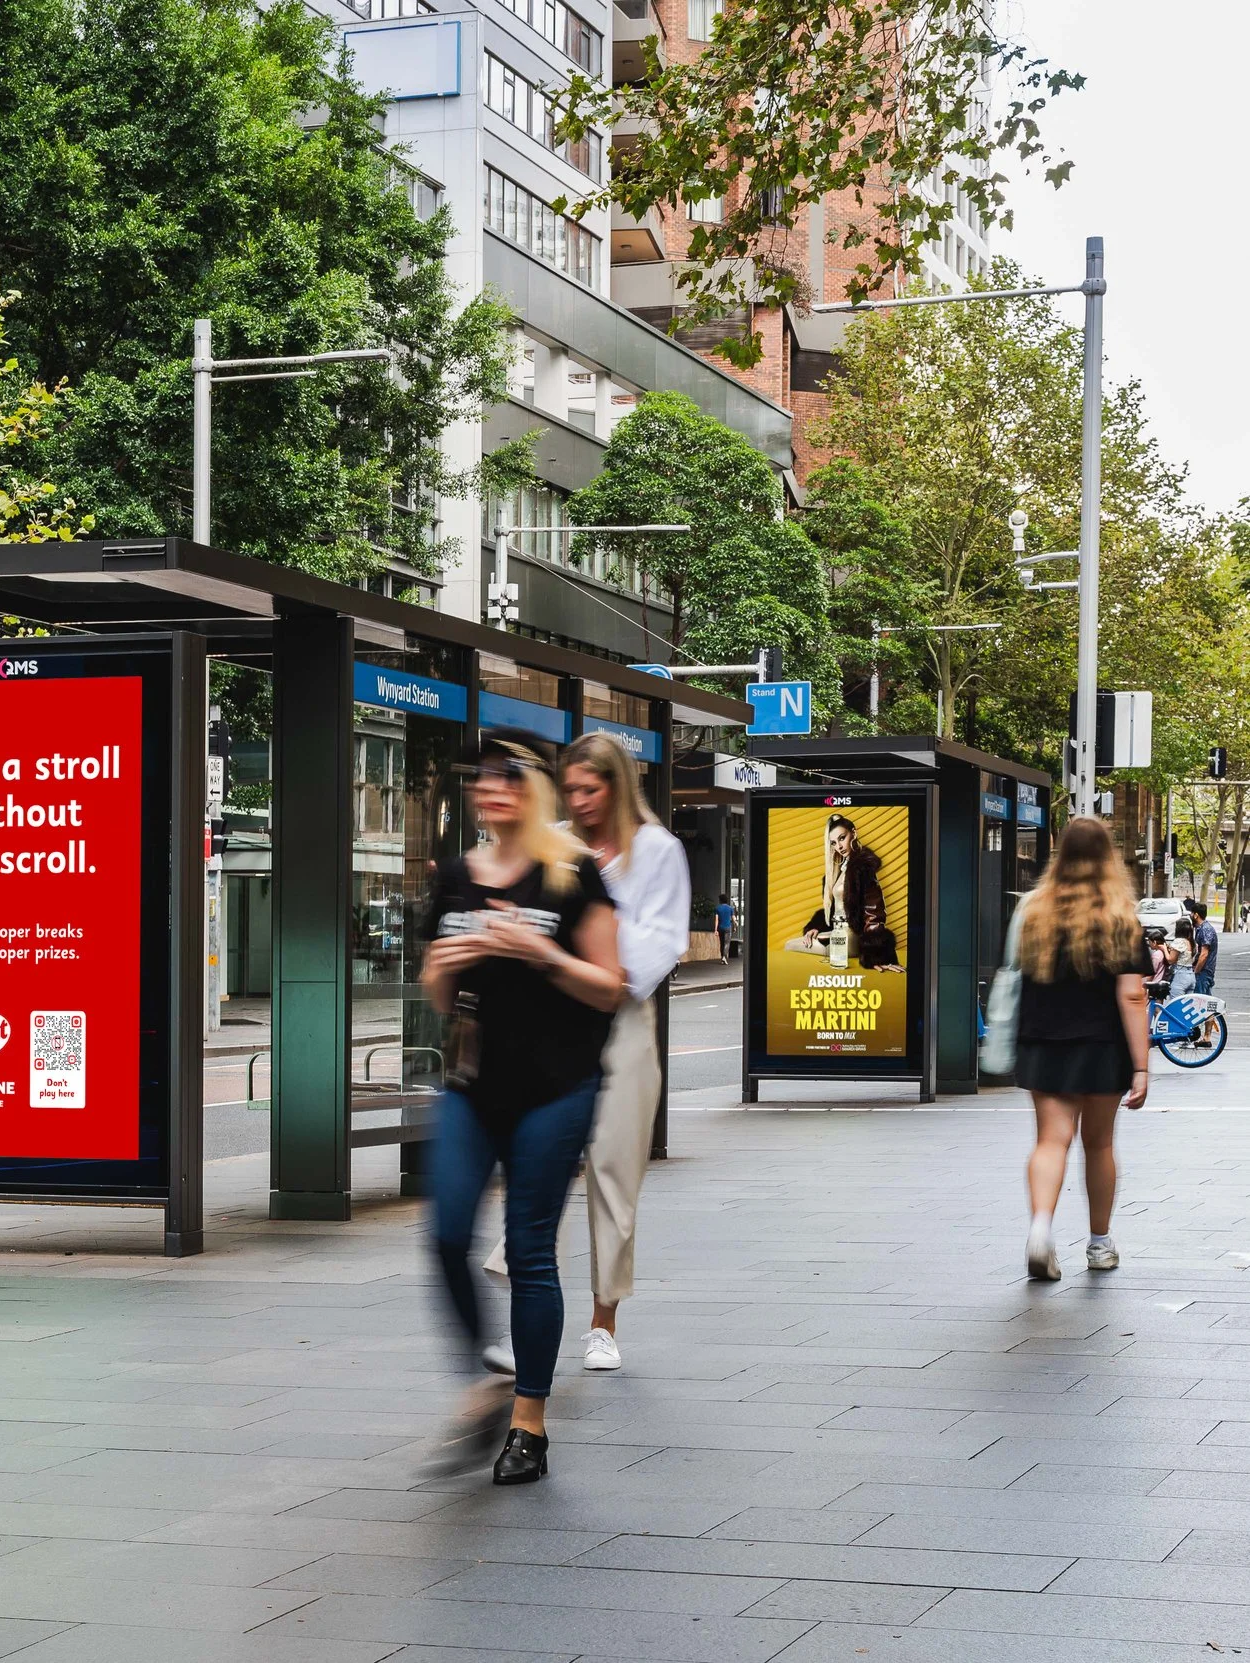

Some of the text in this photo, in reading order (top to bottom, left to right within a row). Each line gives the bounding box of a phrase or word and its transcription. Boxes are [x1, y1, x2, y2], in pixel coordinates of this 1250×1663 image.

[0, 658, 39, 678] QMS
[377, 675, 440, 710] Wynyard Station
[752, 687, 803, 717] Stand N
[622, 731, 643, 753] Station
[2, 758, 21, 781] a
[35, 745, 120, 781] stroll
[210, 761, 221, 772] ONE
[210, 775, 221, 785] WAY
[735, 767, 762, 787] NOVOTEL
[0, 840, 97, 874] scroll.
[36, 923, 83, 938] breaks
[35, 945, 80, 964] prizes.
[790, 989, 882, 1010] ESPRESSO
[795, 1010, 876, 1030] MARTINI
[817, 1031, 835, 1040] BORN
[835, 1031, 843, 1040] TO
[46, 1078, 68, 1087] Don't
[39, 1089, 75, 1099] play here
